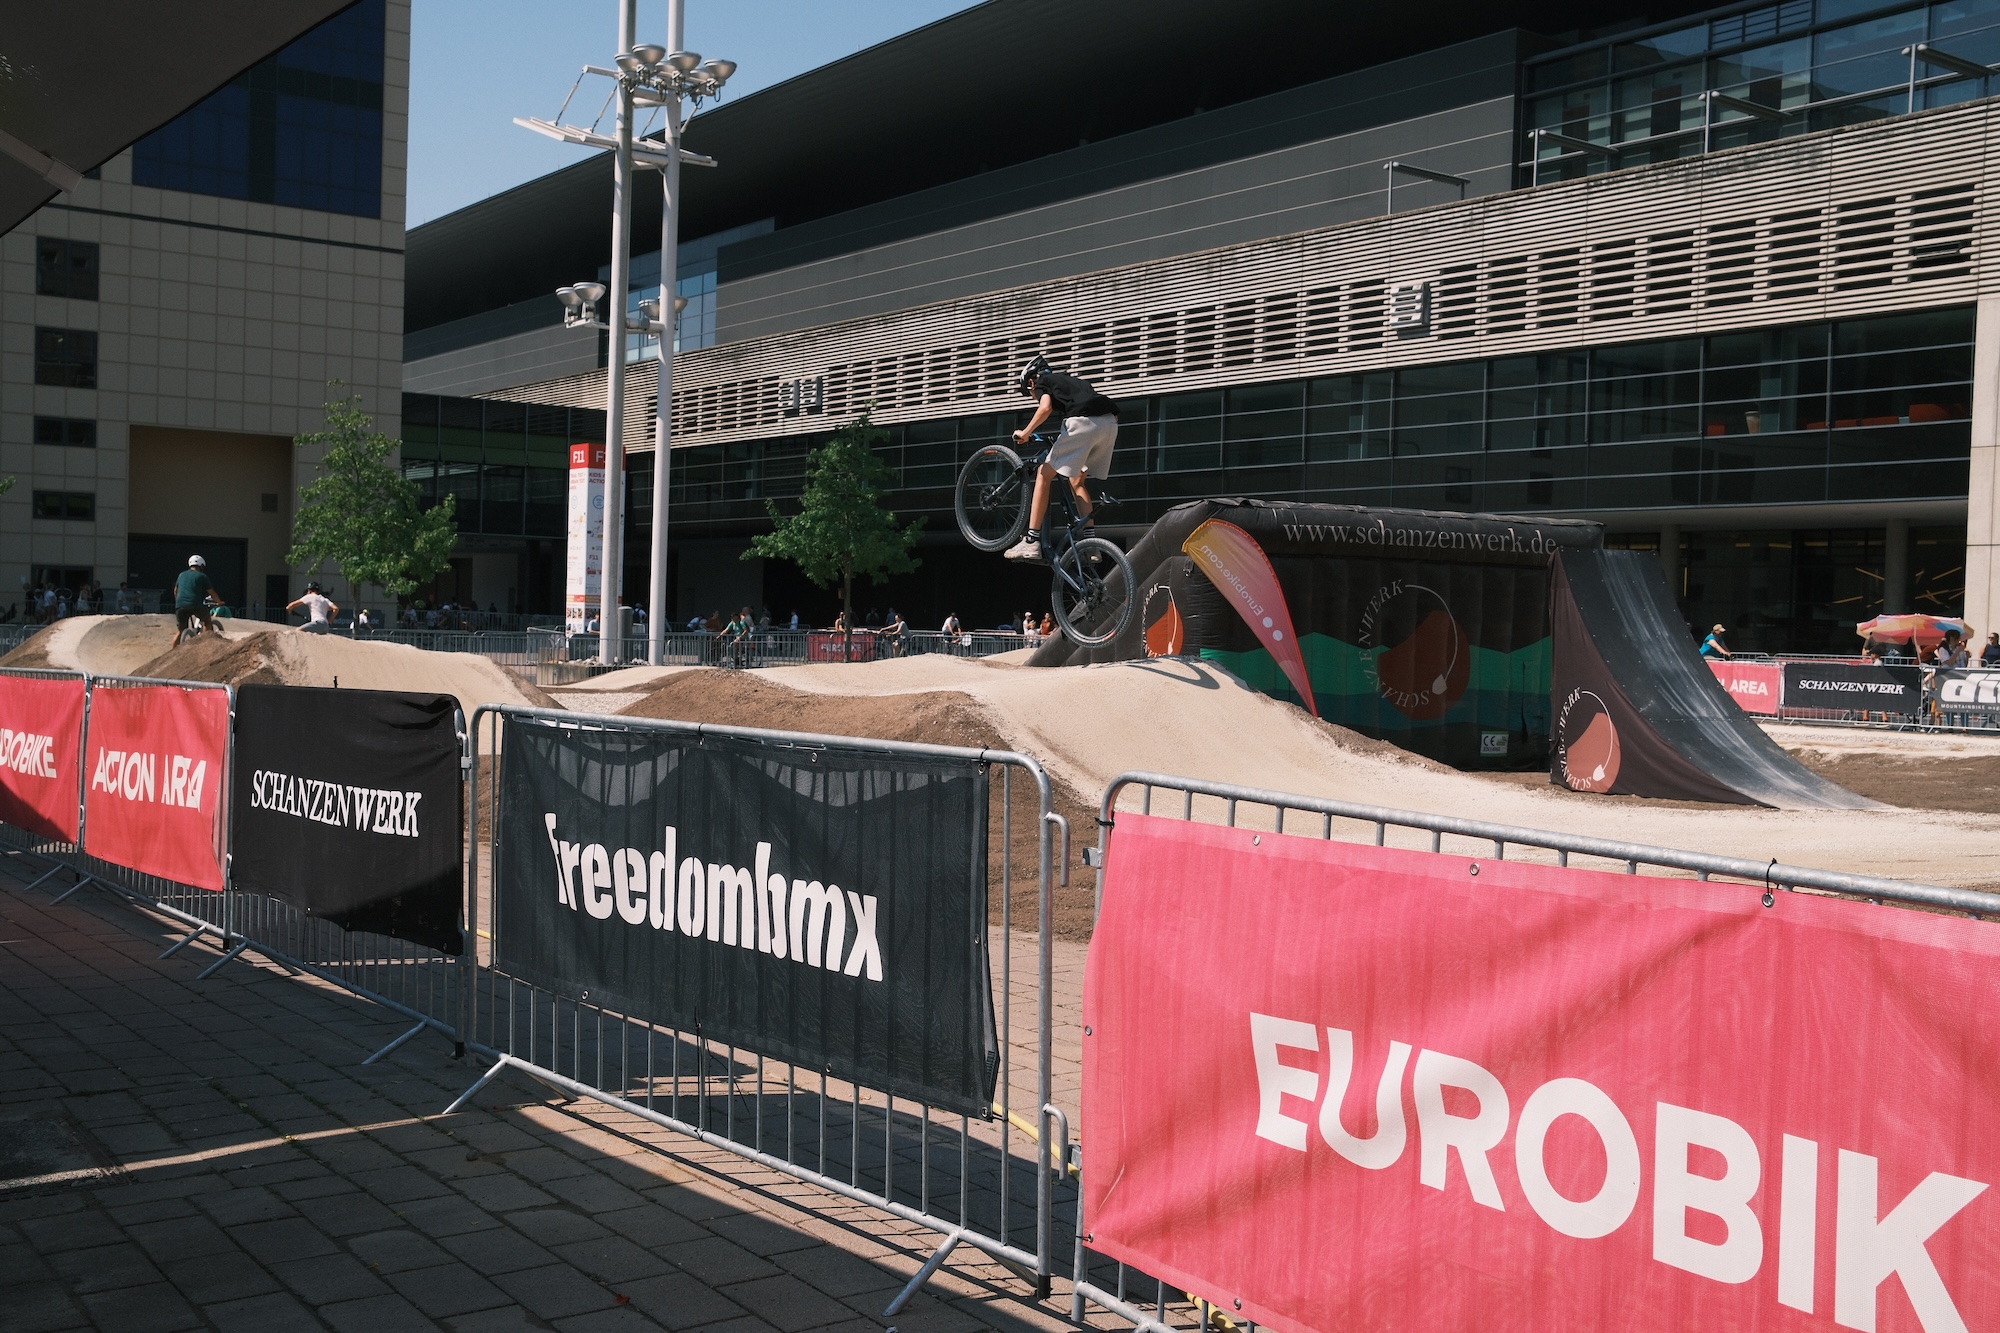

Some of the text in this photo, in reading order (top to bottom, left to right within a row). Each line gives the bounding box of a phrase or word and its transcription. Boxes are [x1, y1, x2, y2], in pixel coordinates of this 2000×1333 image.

[573, 450, 585, 463] F11
[1283, 519, 1556, 554] www.schanzenwerk.de
[1729, 679, 1768, 695] AREA
[1799, 680, 1905, 694] SCHANZENWERK
[251, 769, 422, 837] SCHANZENWERK
[544, 812, 883, 982] freedombmx
[1250, 1011, 1990, 1333] EUROBIK
